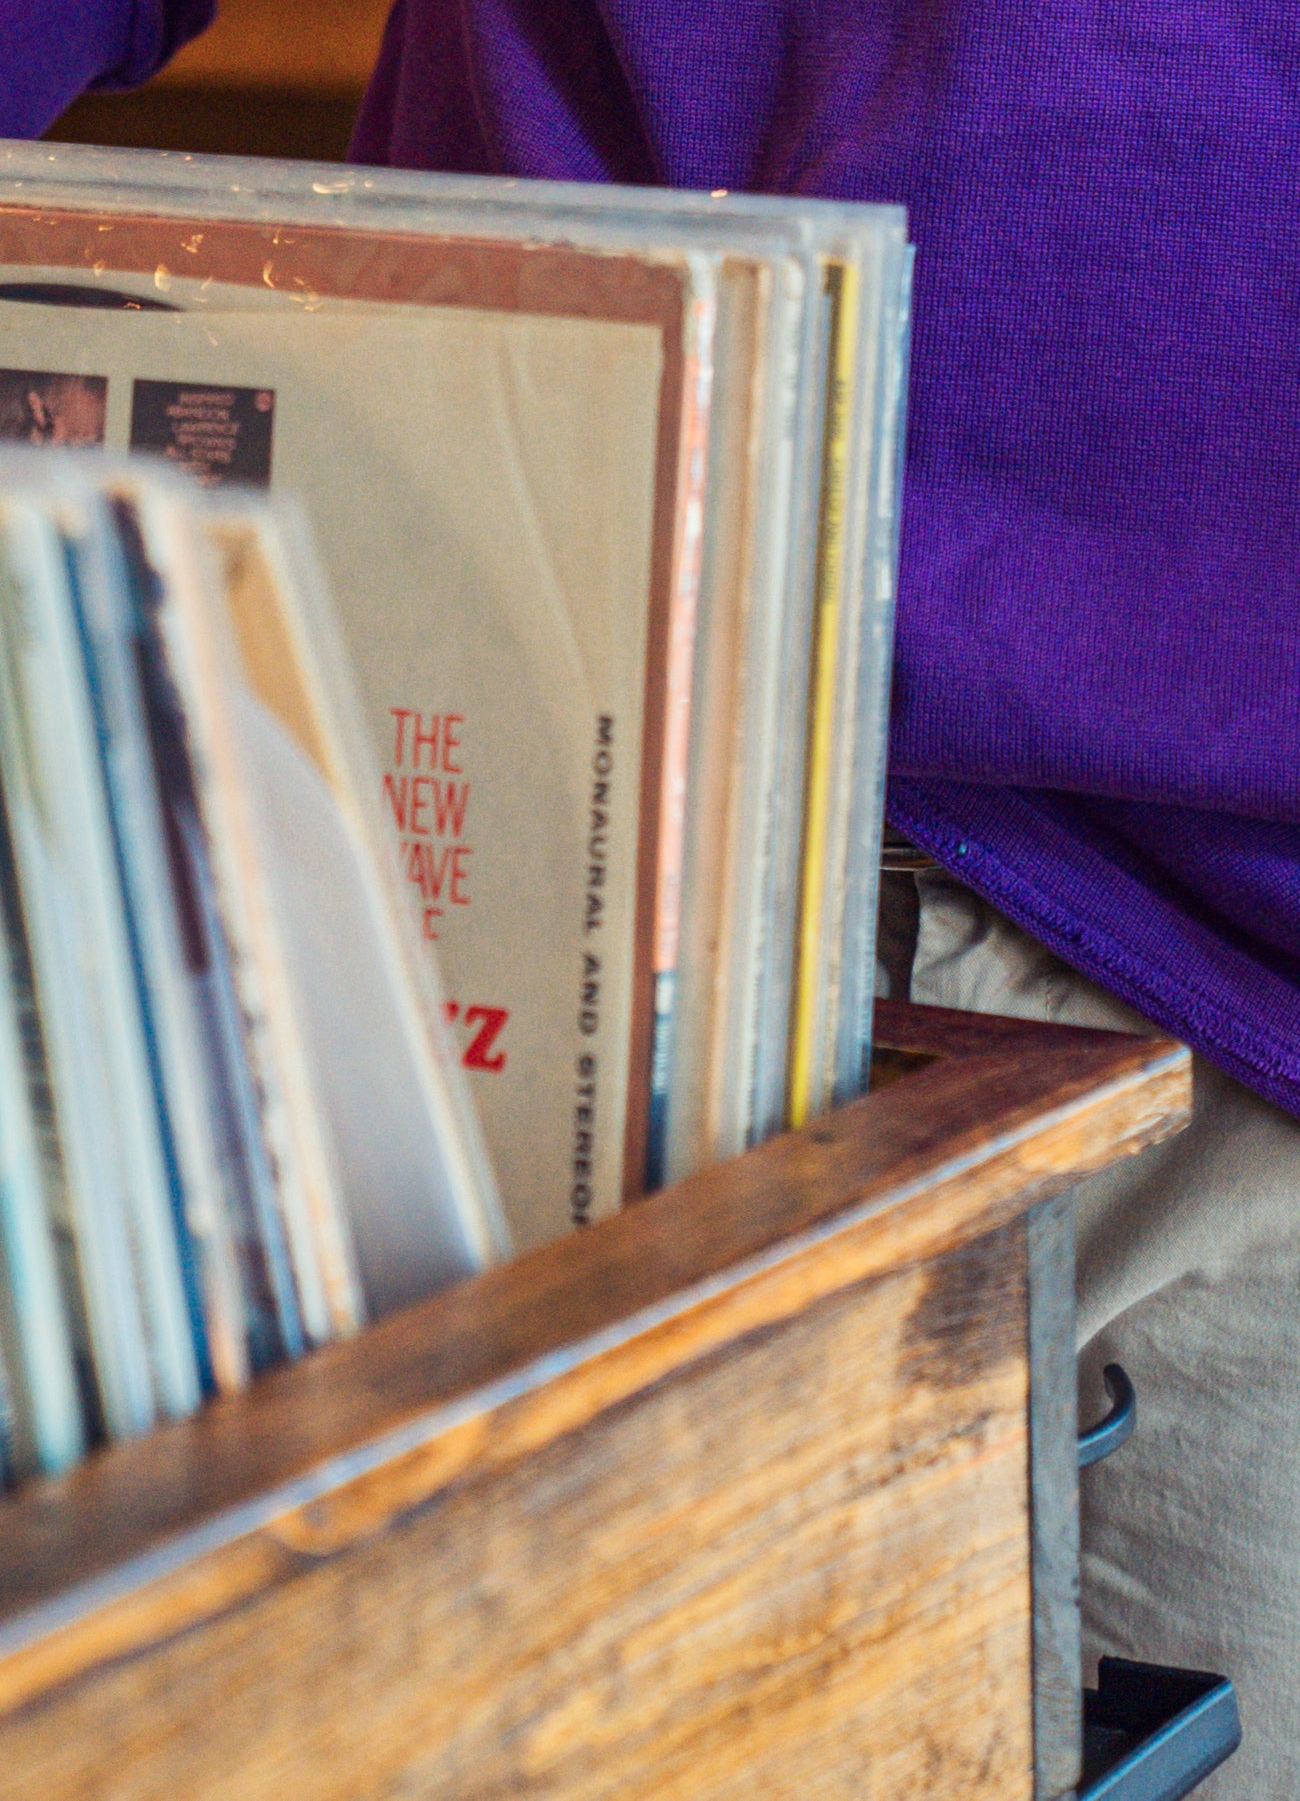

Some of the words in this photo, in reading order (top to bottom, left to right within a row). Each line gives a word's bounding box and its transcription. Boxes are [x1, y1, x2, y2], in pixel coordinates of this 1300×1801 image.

[390, 707, 465, 774] THE
[383, 772, 470, 839] NEW
[585, 713, 613, 936] MONAURAL
[400, 840, 472, 906] AVE
[577, 951, 601, 1036] AND
